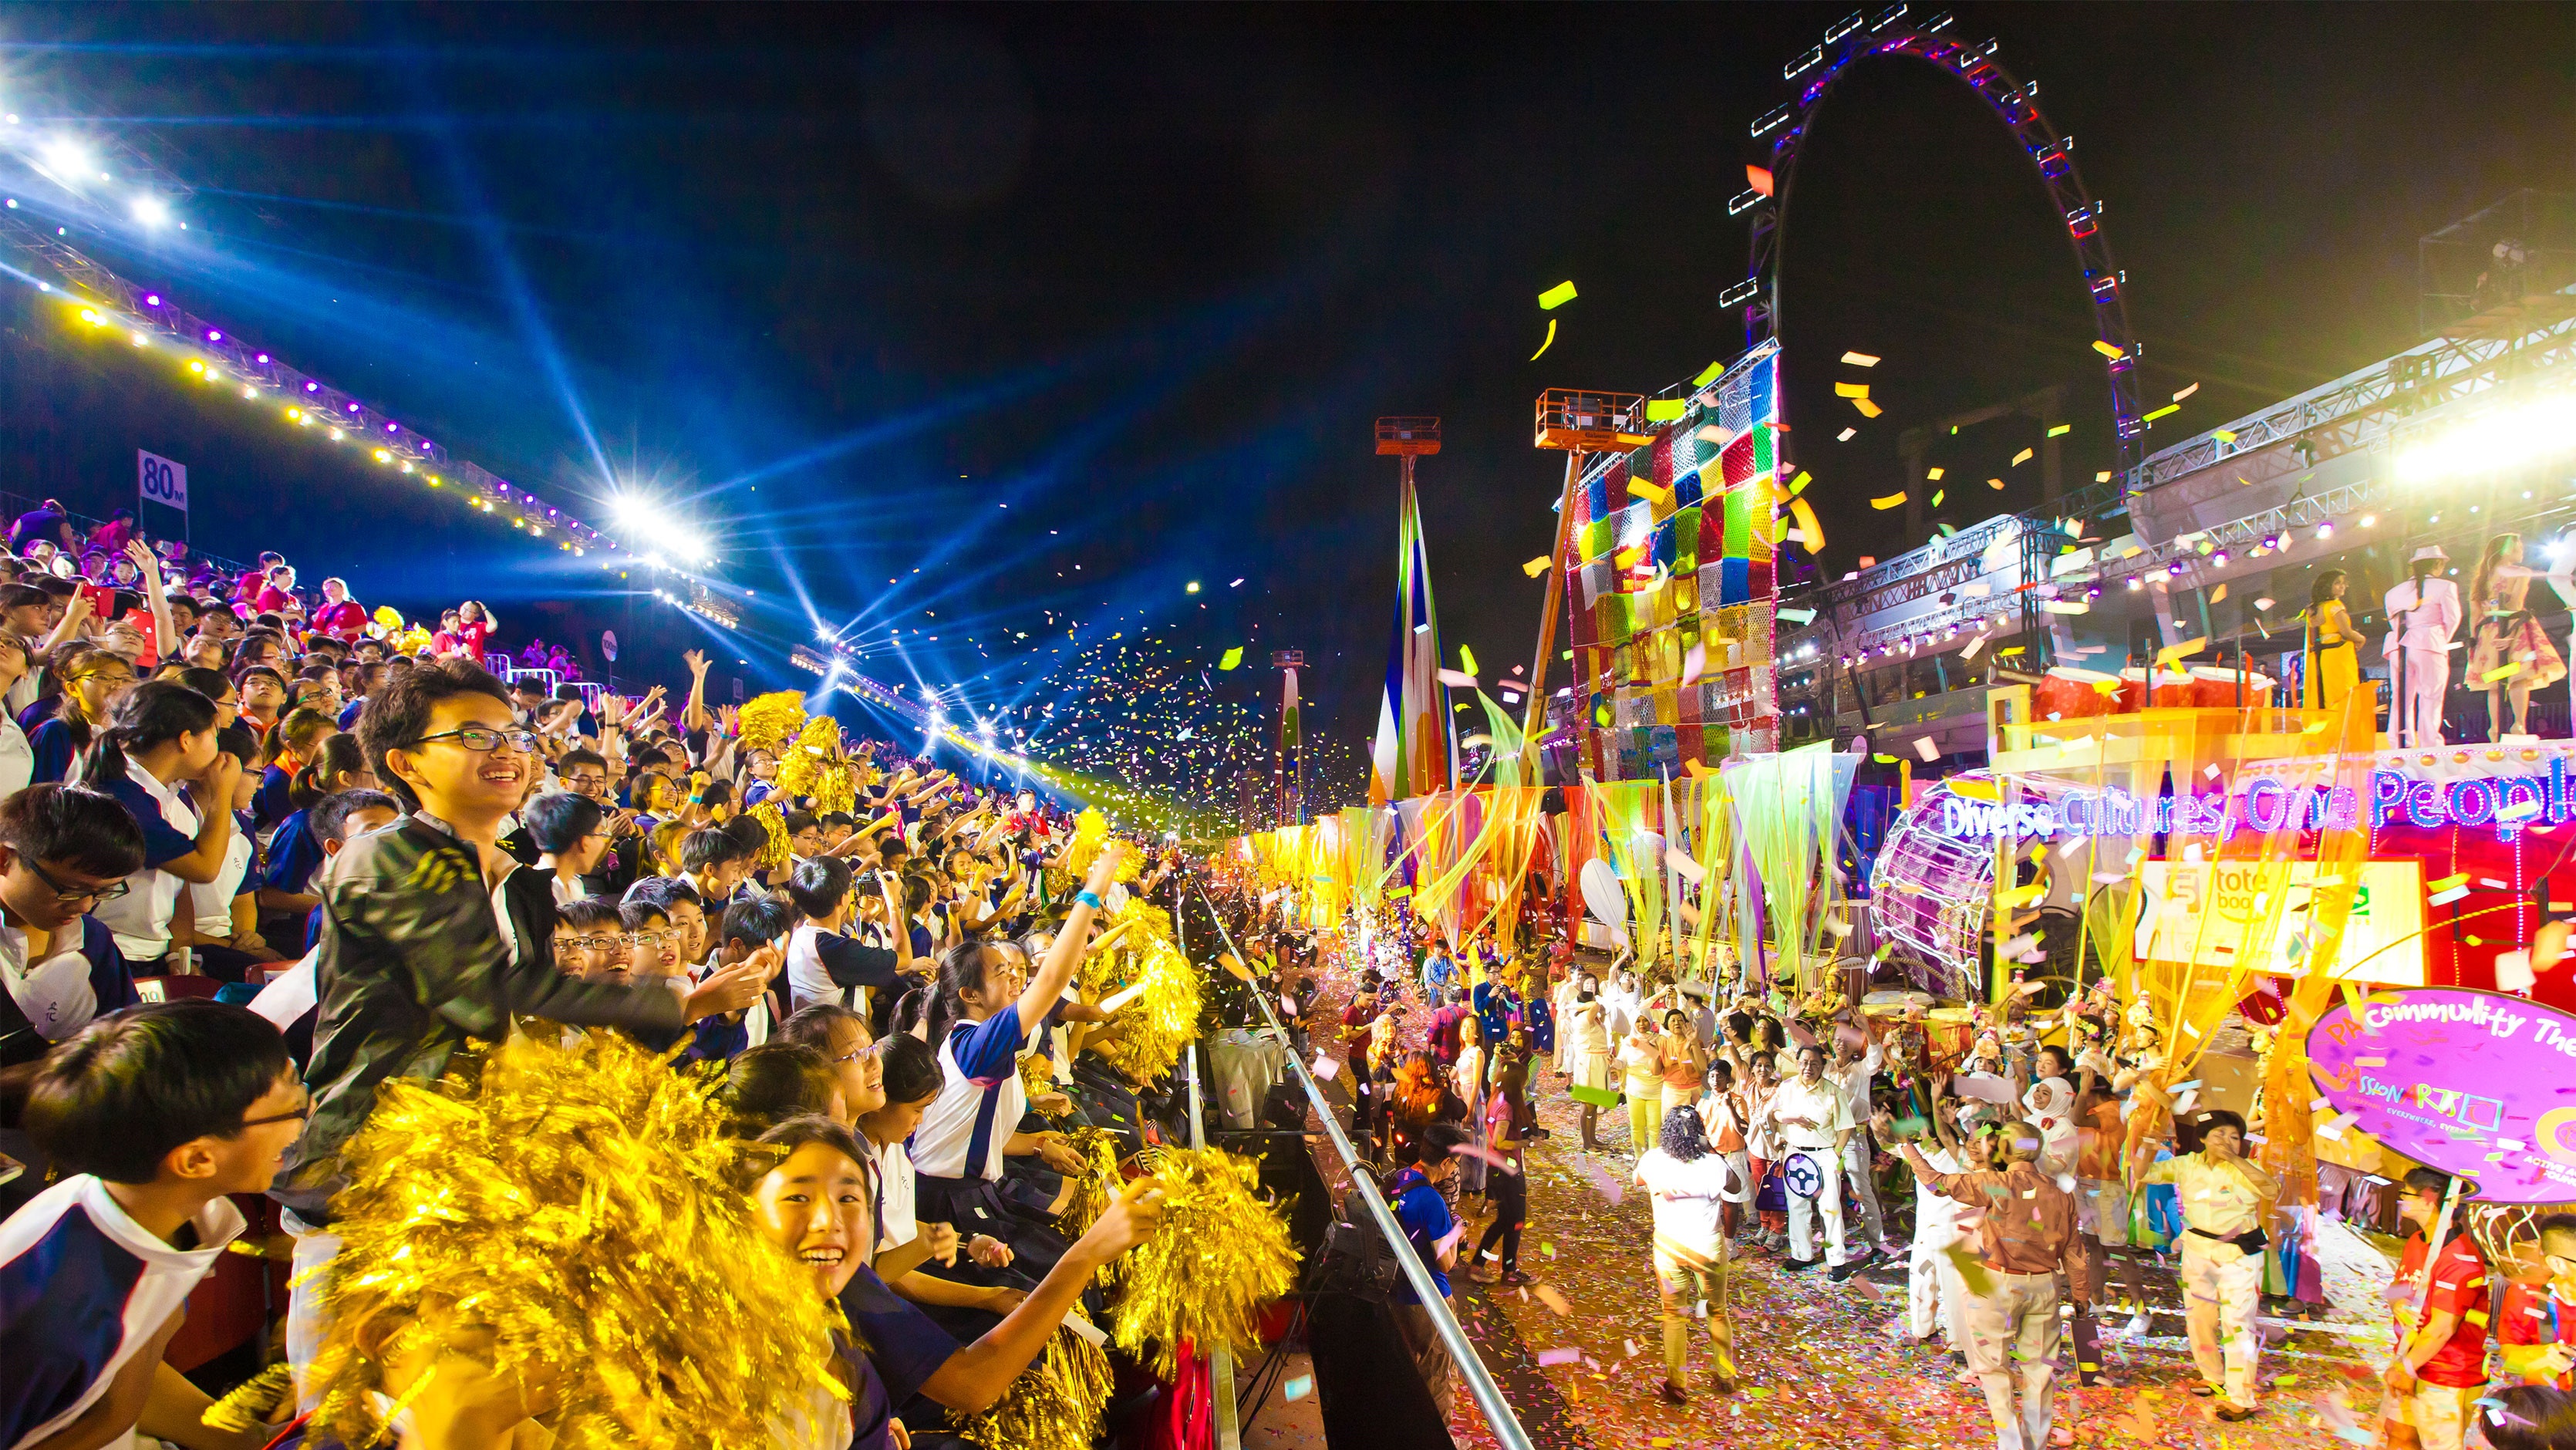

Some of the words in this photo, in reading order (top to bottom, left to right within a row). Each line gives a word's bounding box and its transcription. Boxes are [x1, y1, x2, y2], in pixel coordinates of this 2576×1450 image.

[1944, 797, 2054, 838] Diverse
[2244, 776, 2357, 833] One
[2368, 753, 2576, 842] Peopl
[2216, 868, 2268, 892] tote
[2217, 893, 2269, 910] boa
[2325, 1017, 2366, 1046] PA
[2523, 1155, 2567, 1173] ACTIVE
